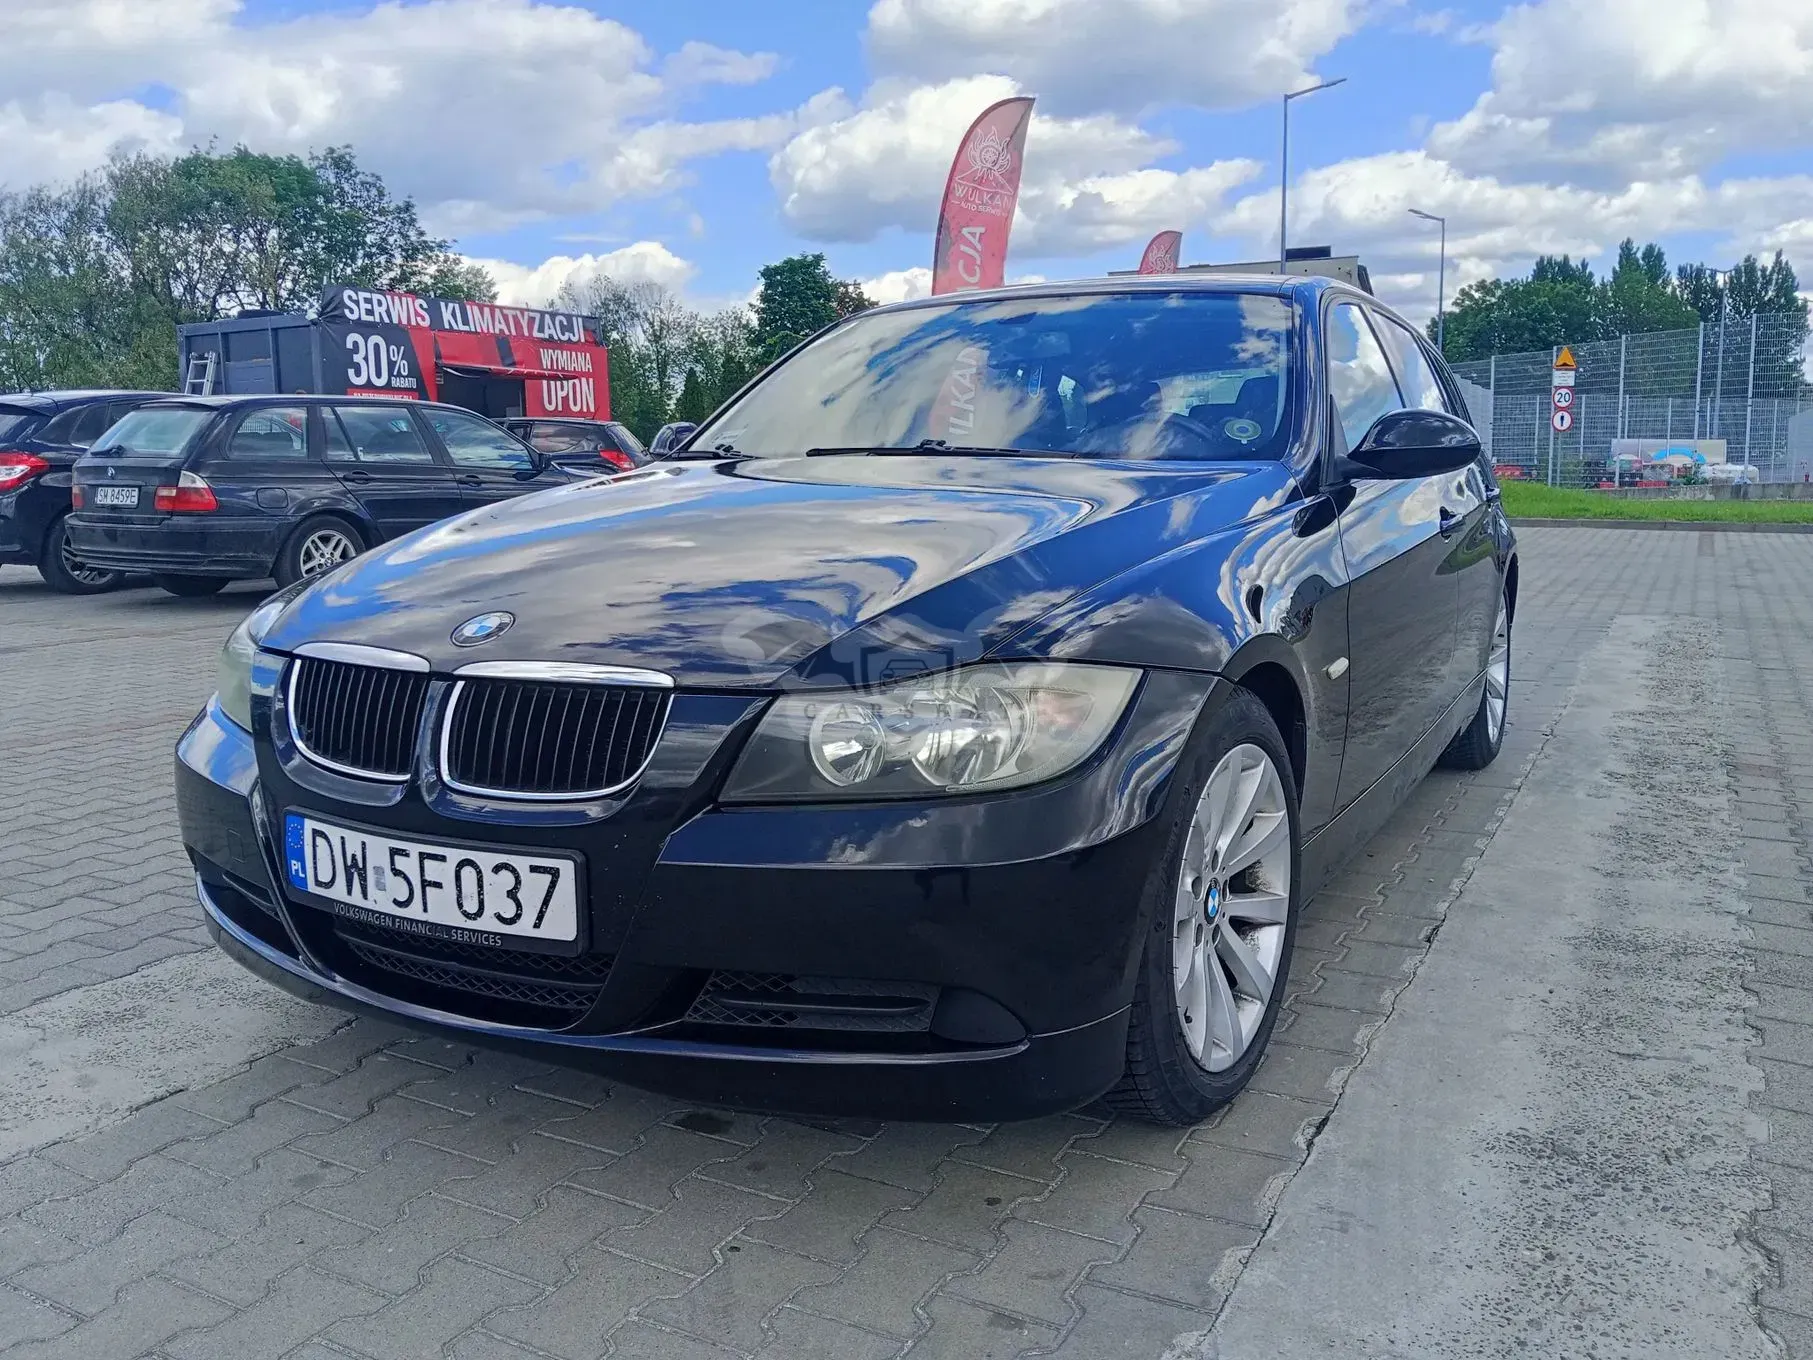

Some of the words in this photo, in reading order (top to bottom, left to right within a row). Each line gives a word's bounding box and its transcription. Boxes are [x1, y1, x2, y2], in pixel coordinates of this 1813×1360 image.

[954, 183, 1012, 209] WULKAN
[342, 289, 431, 328] SERWIS
[440, 301, 586, 344] KLIMATYZACJI
[345, 332, 408, 387] 30%
[540, 348, 593, 373] WYMIANA
[391, 376, 417, 389] RABATU
[1557, 392, 1570, 403] 20
[290, 859, 306, 878] PL
[311, 827, 369, 900] DW
[388, 845, 561, 930] 5F037
[333, 902, 393, 929] VOLKSWAGEN
[395, 919, 449, 939] FINANCIAL
[451, 929, 502, 947] SERVICES
